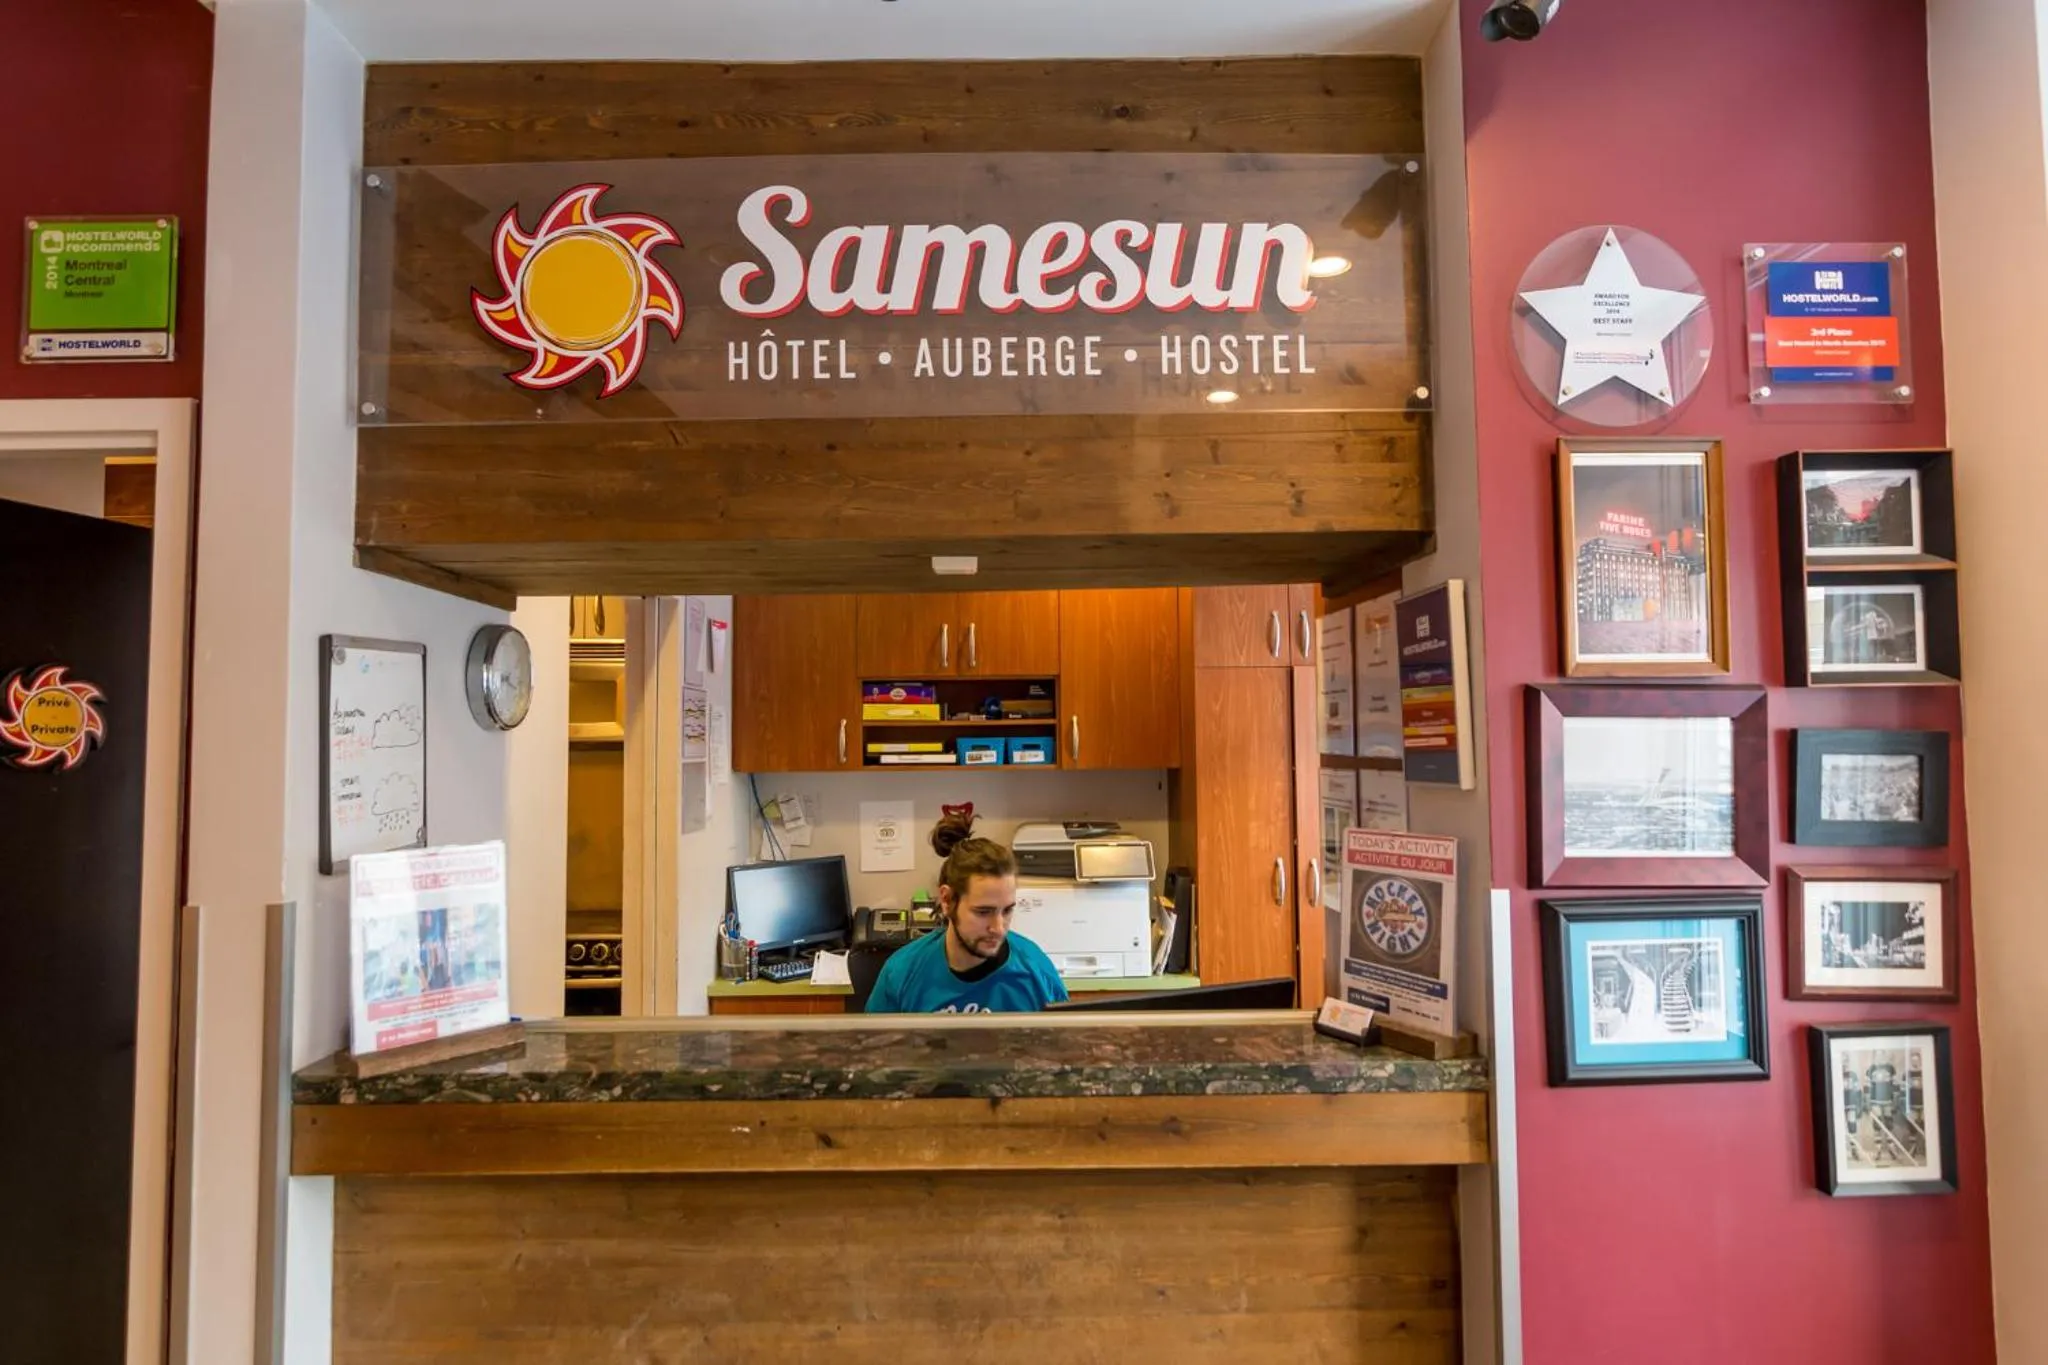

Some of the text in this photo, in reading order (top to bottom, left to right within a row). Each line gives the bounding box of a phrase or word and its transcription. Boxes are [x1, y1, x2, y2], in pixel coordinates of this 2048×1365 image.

[66, 230, 162, 241] HOSTELWORLD
[66, 241, 161, 252] recommends
[719, 184, 1318, 318] Samesun
[64, 259, 127, 271] Montreal
[45, 256, 57, 290] 2014
[64, 274, 115, 286] Central
[1827, 327, 1853, 337] Place
[58, 340, 142, 350] HOSTELWORLD
[727, 328, 1316, 381] HÔTEL AUBERGE HOSTEL
[1607, 512, 1645, 527] FARINE
[1599, 520, 1619, 534] FIVE
[37, 697, 71, 707] Privé
[31, 724, 77, 734] Private
[1352, 836, 1451, 855] TODAY'S ACTIVITY
[1401, 857, 1417, 870] DU
[1418, 859, 1447, 872] JOUR
[1366, 882, 1425, 917] HOCKEY
[1367, 919, 1421, 952] NIGHT
